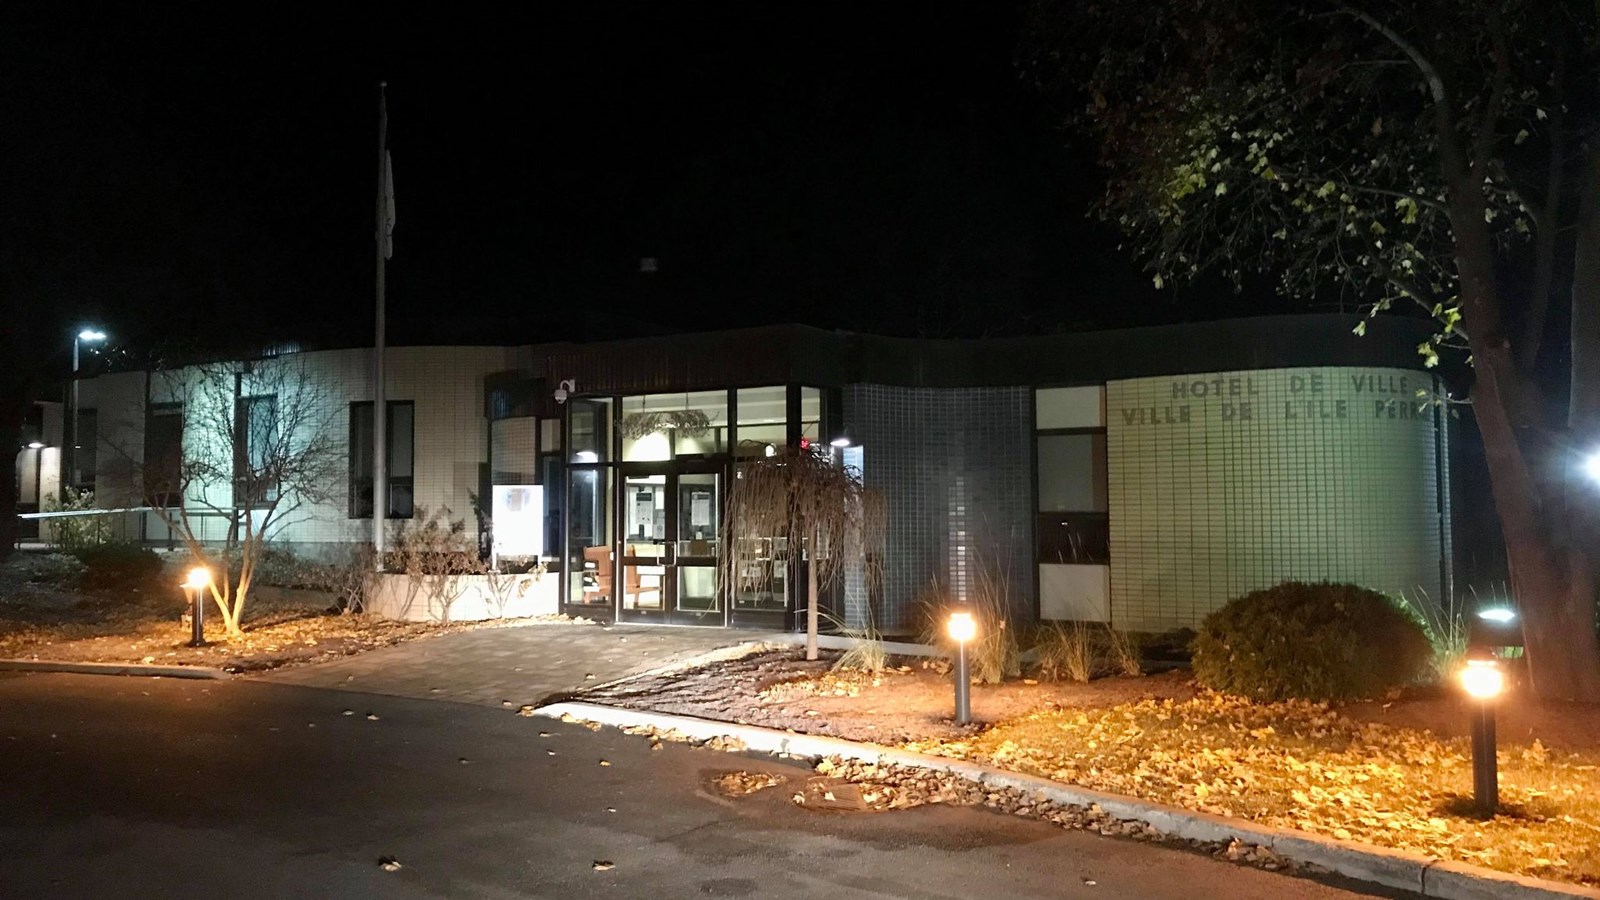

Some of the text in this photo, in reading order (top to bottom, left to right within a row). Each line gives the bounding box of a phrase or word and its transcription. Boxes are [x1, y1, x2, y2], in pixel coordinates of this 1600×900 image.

[1172, 374, 1408, 400] HOTEL DE VILLE
[1121, 405, 1191, 426] VILLE
[1222, 402, 1252, 422] DE
